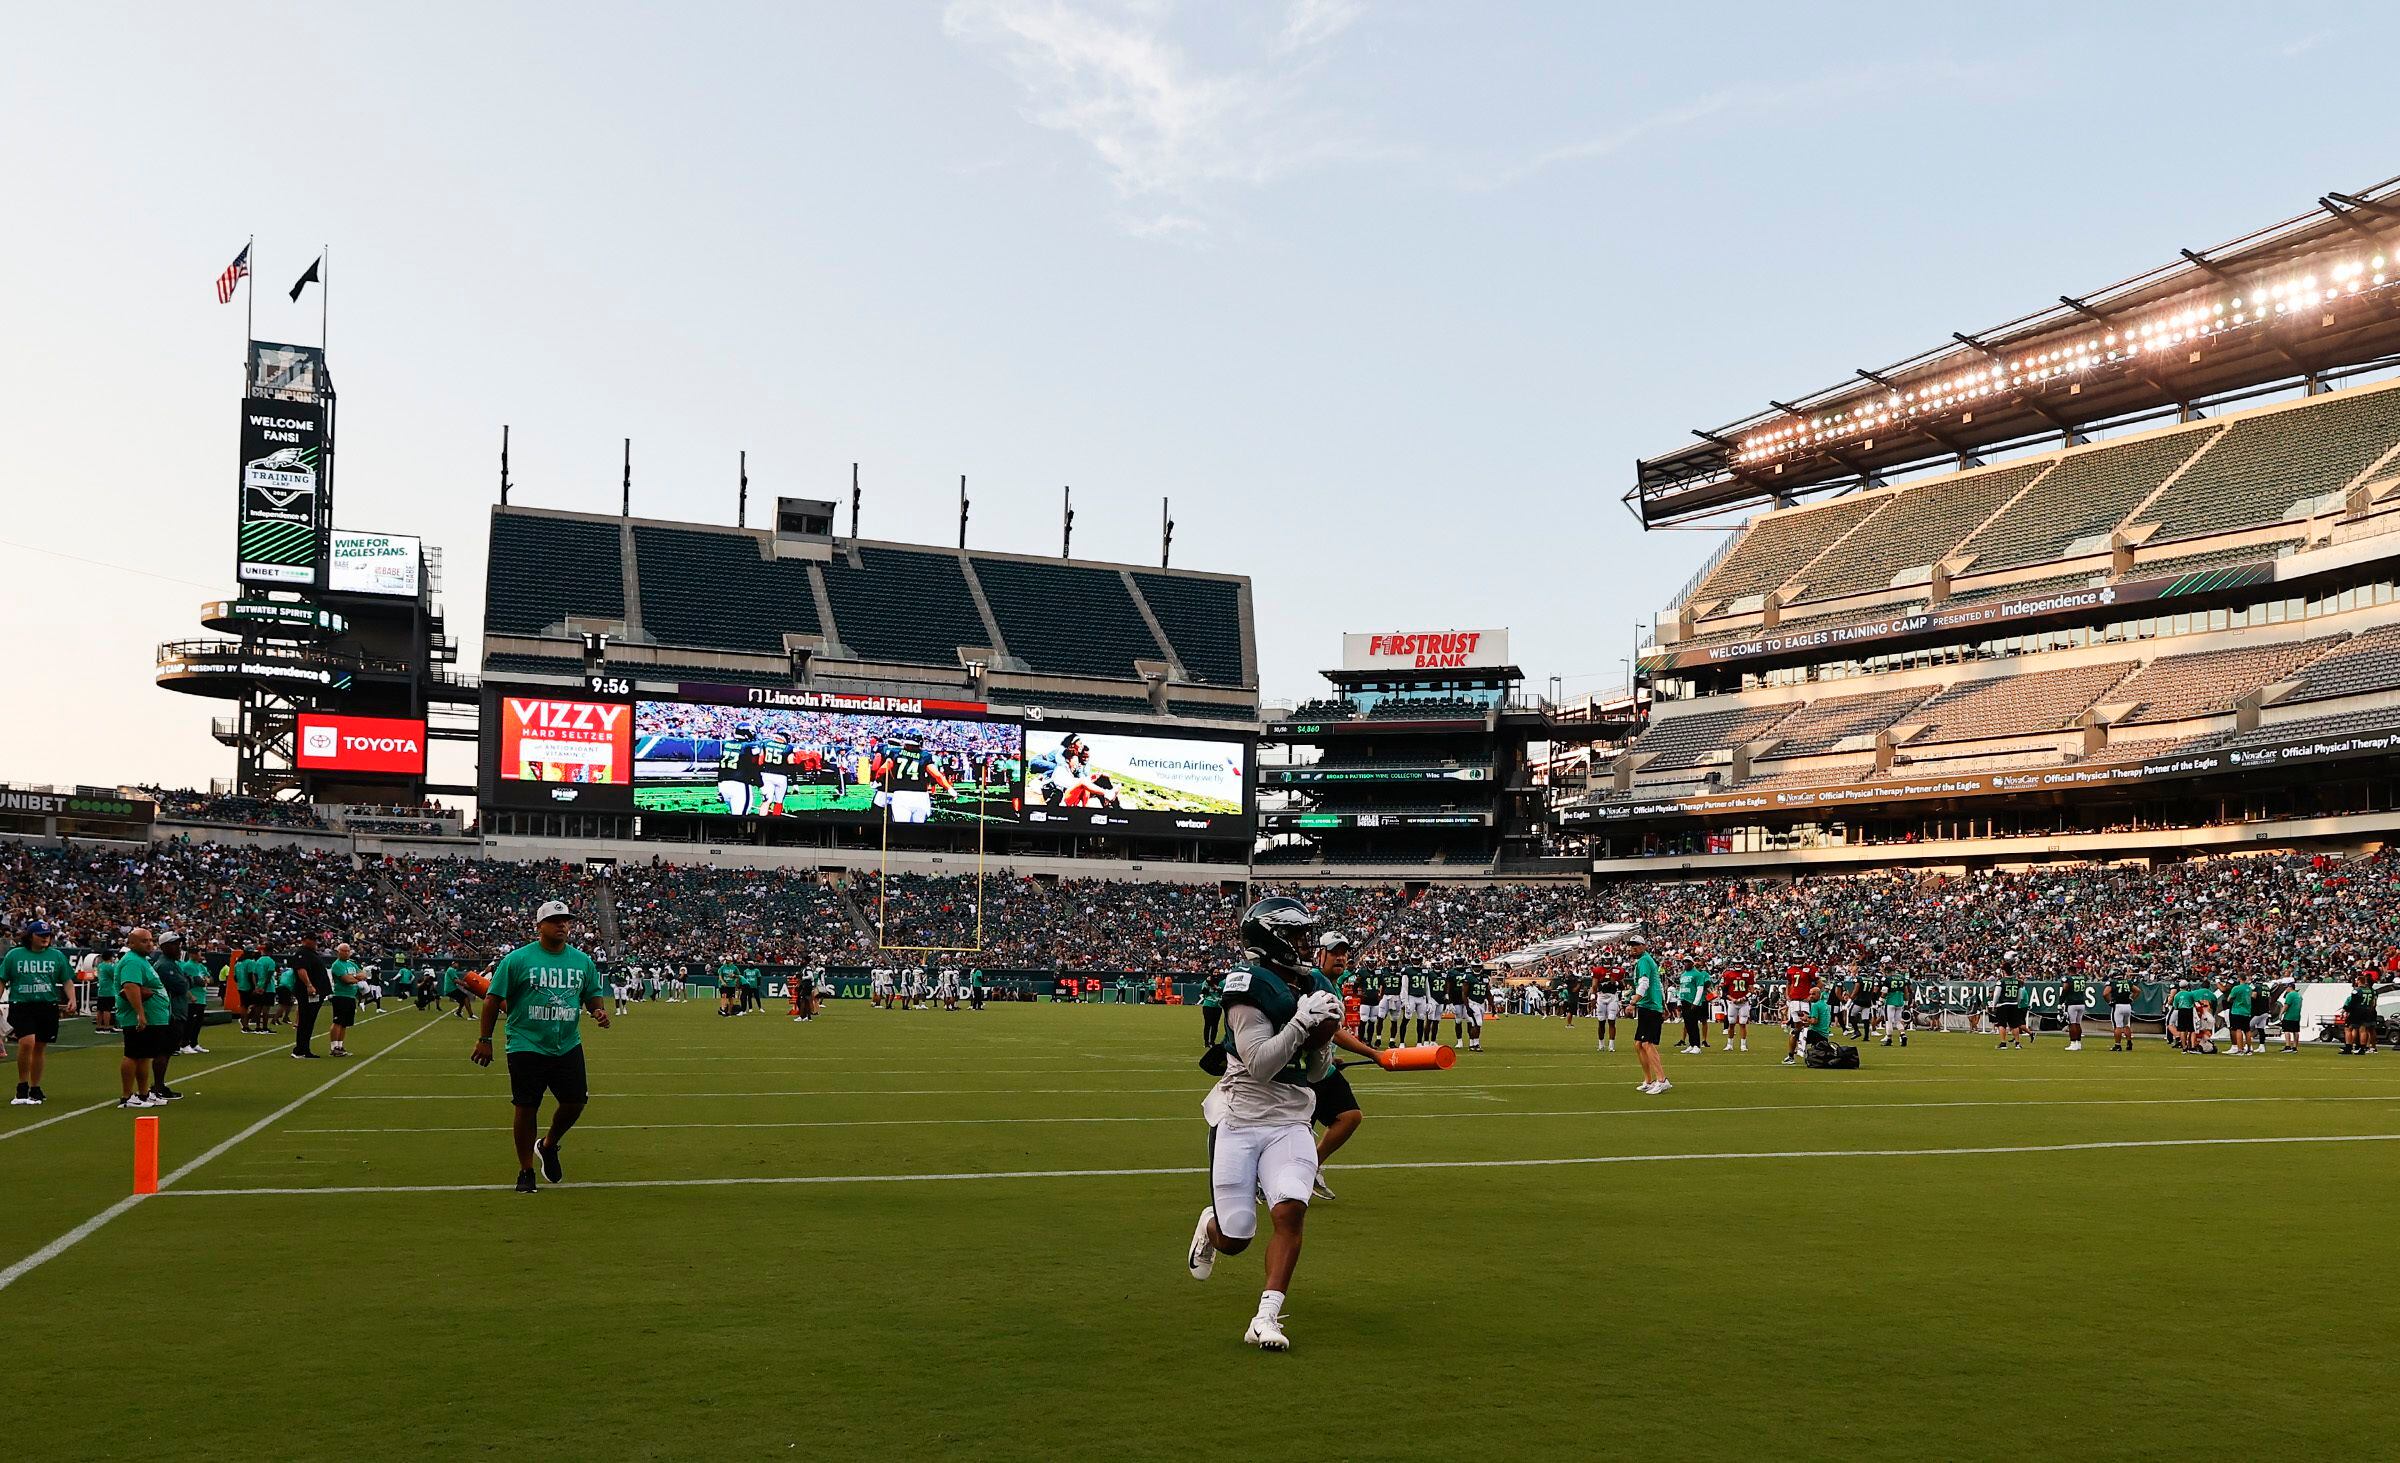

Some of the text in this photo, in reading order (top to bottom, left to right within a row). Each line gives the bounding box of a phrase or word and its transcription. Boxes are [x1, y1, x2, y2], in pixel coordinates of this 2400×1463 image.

[250, 415, 314, 431] WELCOME
[264, 430, 299, 443] FANS!
[252, 472, 309, 483] TRAINING
[250, 510, 299, 520] Independence
[367, 539, 389, 547] FOR
[335, 548, 408, 557] EAGLES FANS.
[246, 568, 280, 576] UNIBET
[235, 605, 313, 619] CUTWATER SPIRITS
[1709, 591, 2096, 659] WELCOME TO EAGLES TRAINING CAMP PRESENTED BY Independence
[1415, 654, 1468, 668] BANK
[241, 663, 319, 680] Independence
[592, 678, 629, 694] 9:56
[765, 689, 922, 713] Lincoln Financial Field
[510, 700, 622, 731] VIZZY
[1026, 708, 1041, 719] 40
[522, 728, 613, 740] HARD SELTZER
[343, 736, 418, 753] TOYOTA
[2282, 746, 2312, 757] Official
[2314, 741, 2350, 756] Physical
[2351, 738, 2389, 750] Therapy
[765, 747, 783, 764] 65
[2241, 749, 2277, 760] NovaCare
[896, 758, 919, 780] 74
[1129, 757, 1224, 771] American Airlines
[2044, 758, 2218, 784] Official Physical Therapy Partner of the Eagles
[2004, 775, 2040, 785] NovaCare
[1786, 792, 1816, 801] NovaCare
[1819, 790, 1844, 800] Official
[1845, 789, 1873, 800] Physical
[1874, 788, 1904, 797] Therapy
[1905, 786, 1932, 794] Partner
[1956, 781, 1980, 791] Eagles
[1633, 806, 1654, 814] Official
[1655, 804, 1678, 813] Physical
[1680, 803, 1704, 812] Therapy
[1705, 801, 1726, 809] Partner
[1746, 797, 1767, 806] Eagles
[1574, 811, 1590, 819] Eagles
[1175, 819, 1207, 829] verizon
[17, 960, 55, 973] EAGLES
[529, 967, 584, 989] EAGLES
[1366, 978, 1378, 990] 14
[1412, 976, 1425, 988] 34
[1794, 975, 1800, 987] 7
[768, 983, 835, 998] EAS
[1086, 980, 1100, 990] 25
[1433, 980, 1445, 991] 32
[1473, 985, 1486, 996] 35
[1733, 980, 1745, 992] 10
[2116, 984, 2130, 993] 79
[1072, 987, 1078, 996] 3
[2005, 986, 2018, 998] 56
